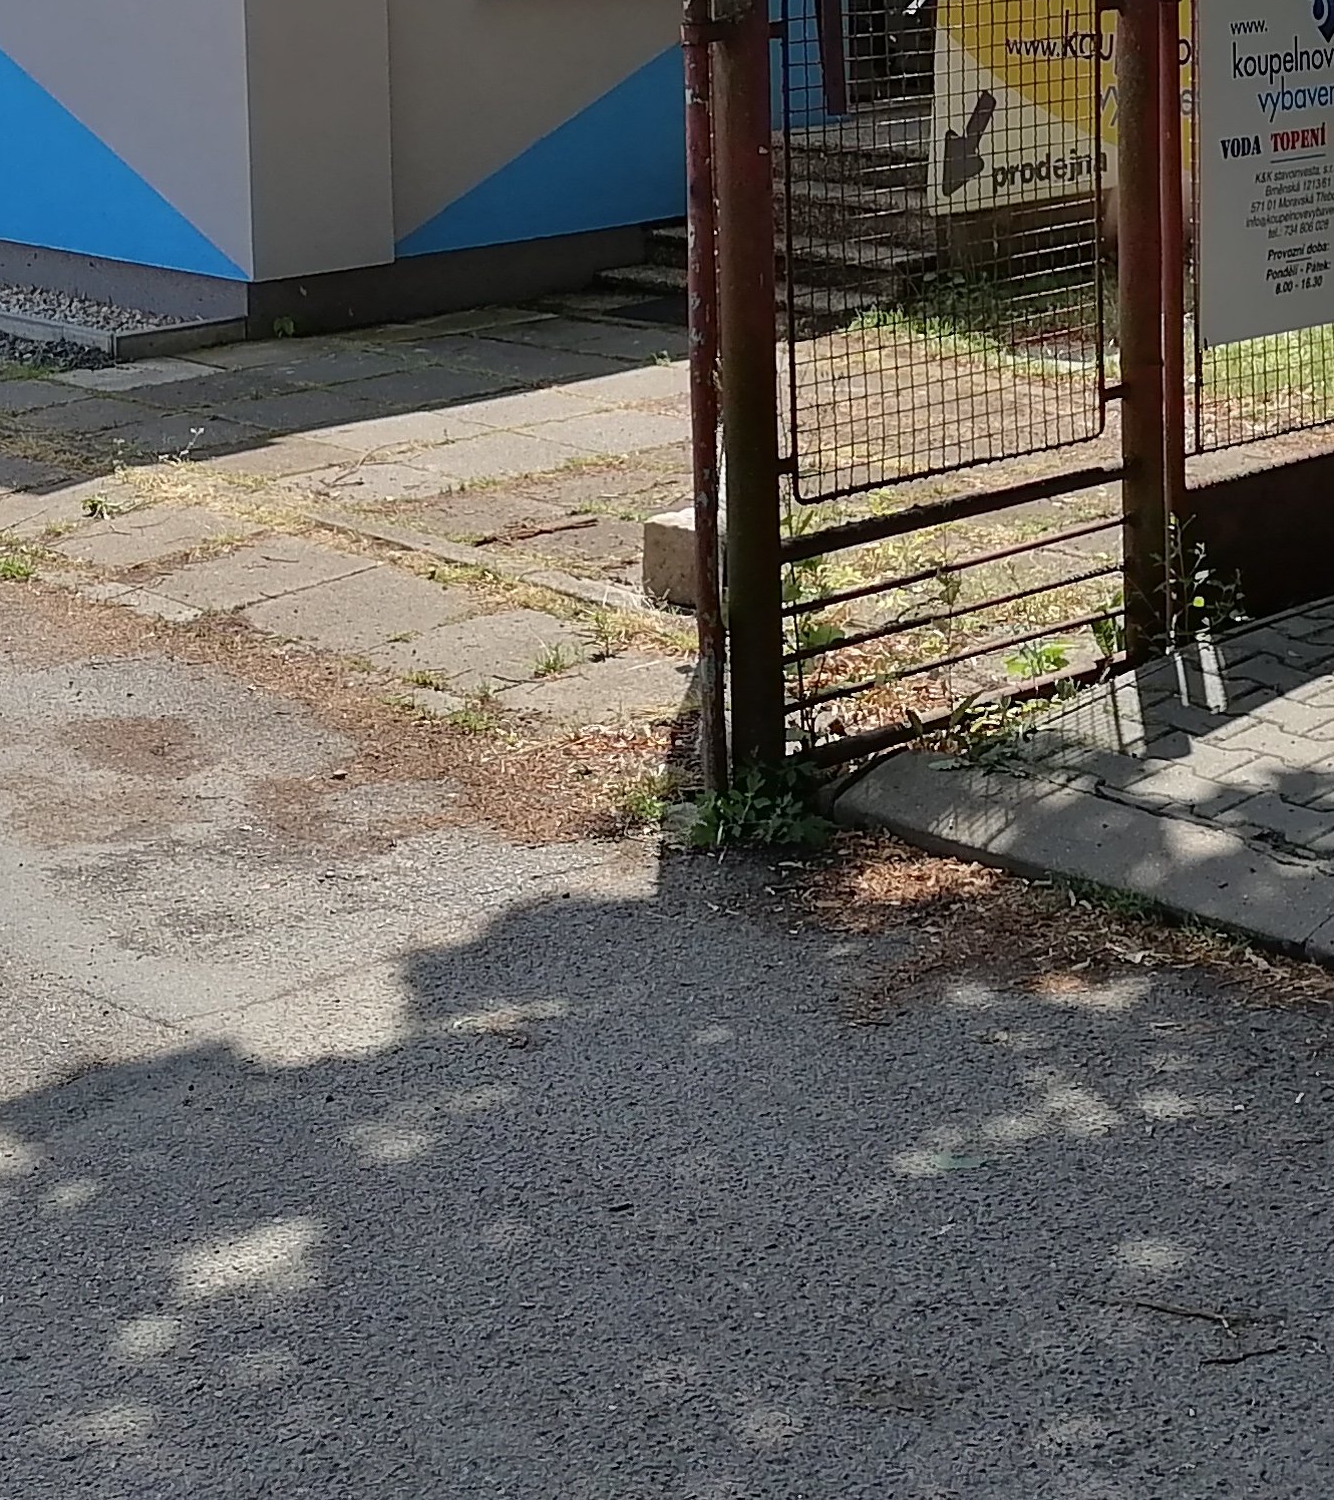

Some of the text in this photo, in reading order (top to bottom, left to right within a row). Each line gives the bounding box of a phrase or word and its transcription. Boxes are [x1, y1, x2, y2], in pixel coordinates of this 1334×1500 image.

[1230, 20, 1268, 35] www.
[1220, 135, 1262, 160] VODA
[1270, 121, 1327, 153] TOPENÍ
[1250, 199, 1265, 213] 571
[1267, 198, 1277, 212] 01
[1267, 242, 1330, 261] Provozní doba:
